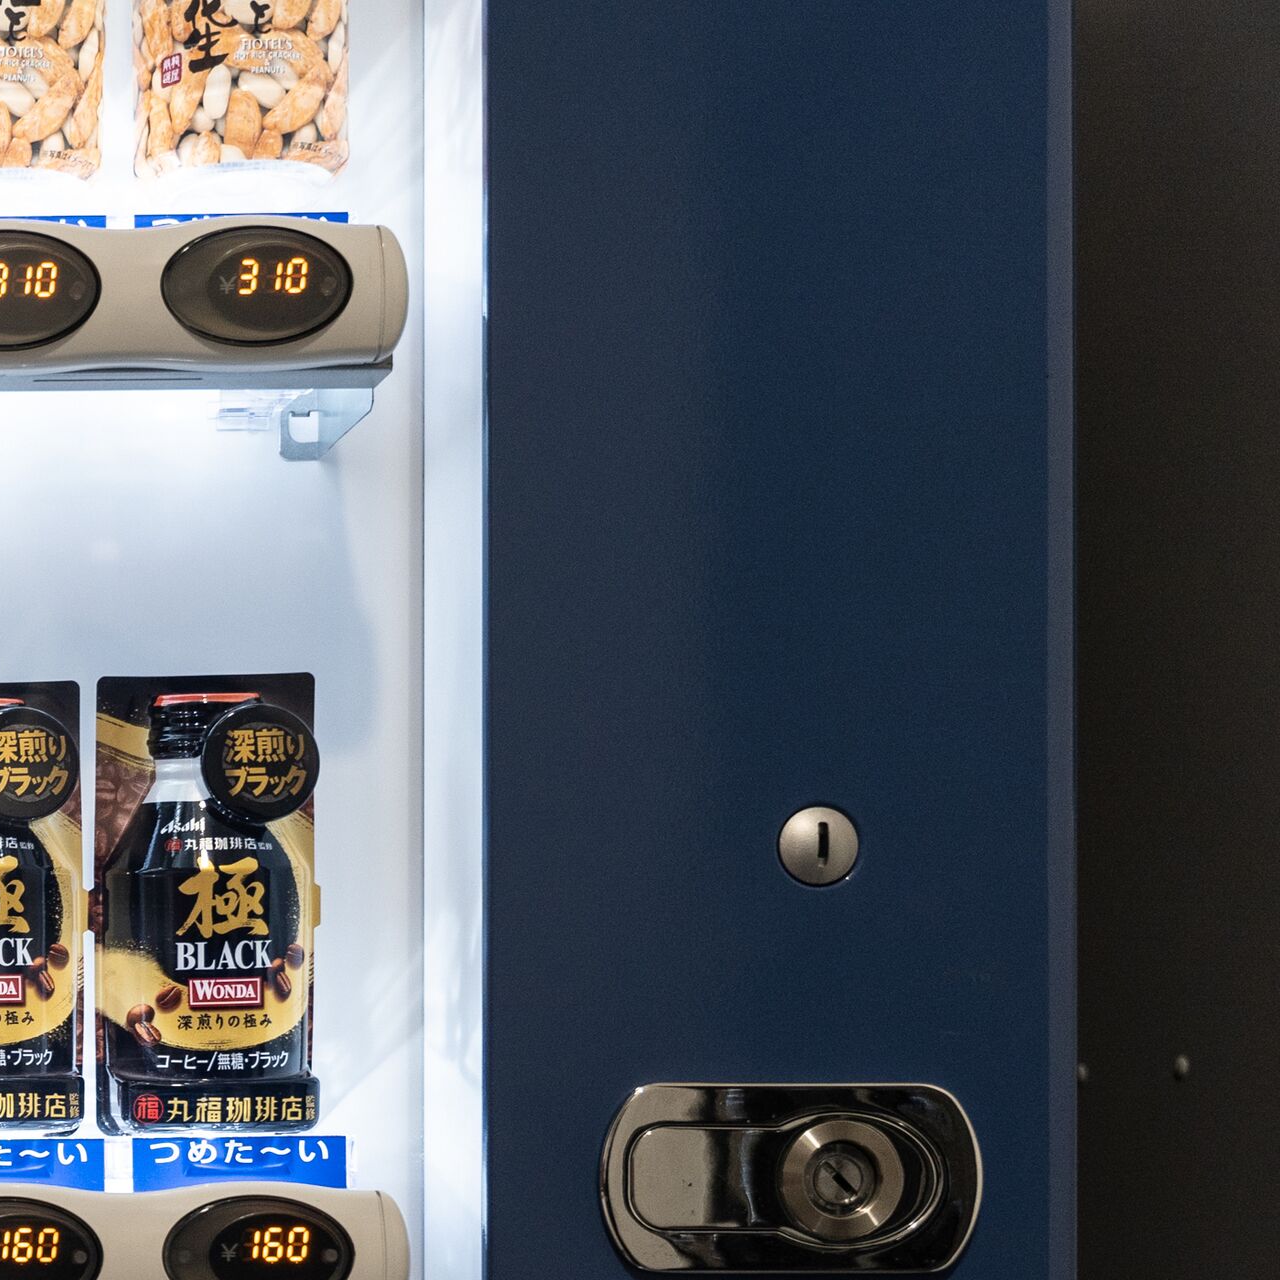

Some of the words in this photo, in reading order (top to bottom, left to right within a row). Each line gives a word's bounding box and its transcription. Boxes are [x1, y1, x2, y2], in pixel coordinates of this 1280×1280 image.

[224, 729, 304, 764] 深煎り
[225, 765, 307, 797] ブラック
[176, 857, 269, 938] 極
[176, 940, 273, 971] BLACK
[193, 980, 256, 999] WONDA
[178, 1013, 272, 1030] 深煎りの極み
